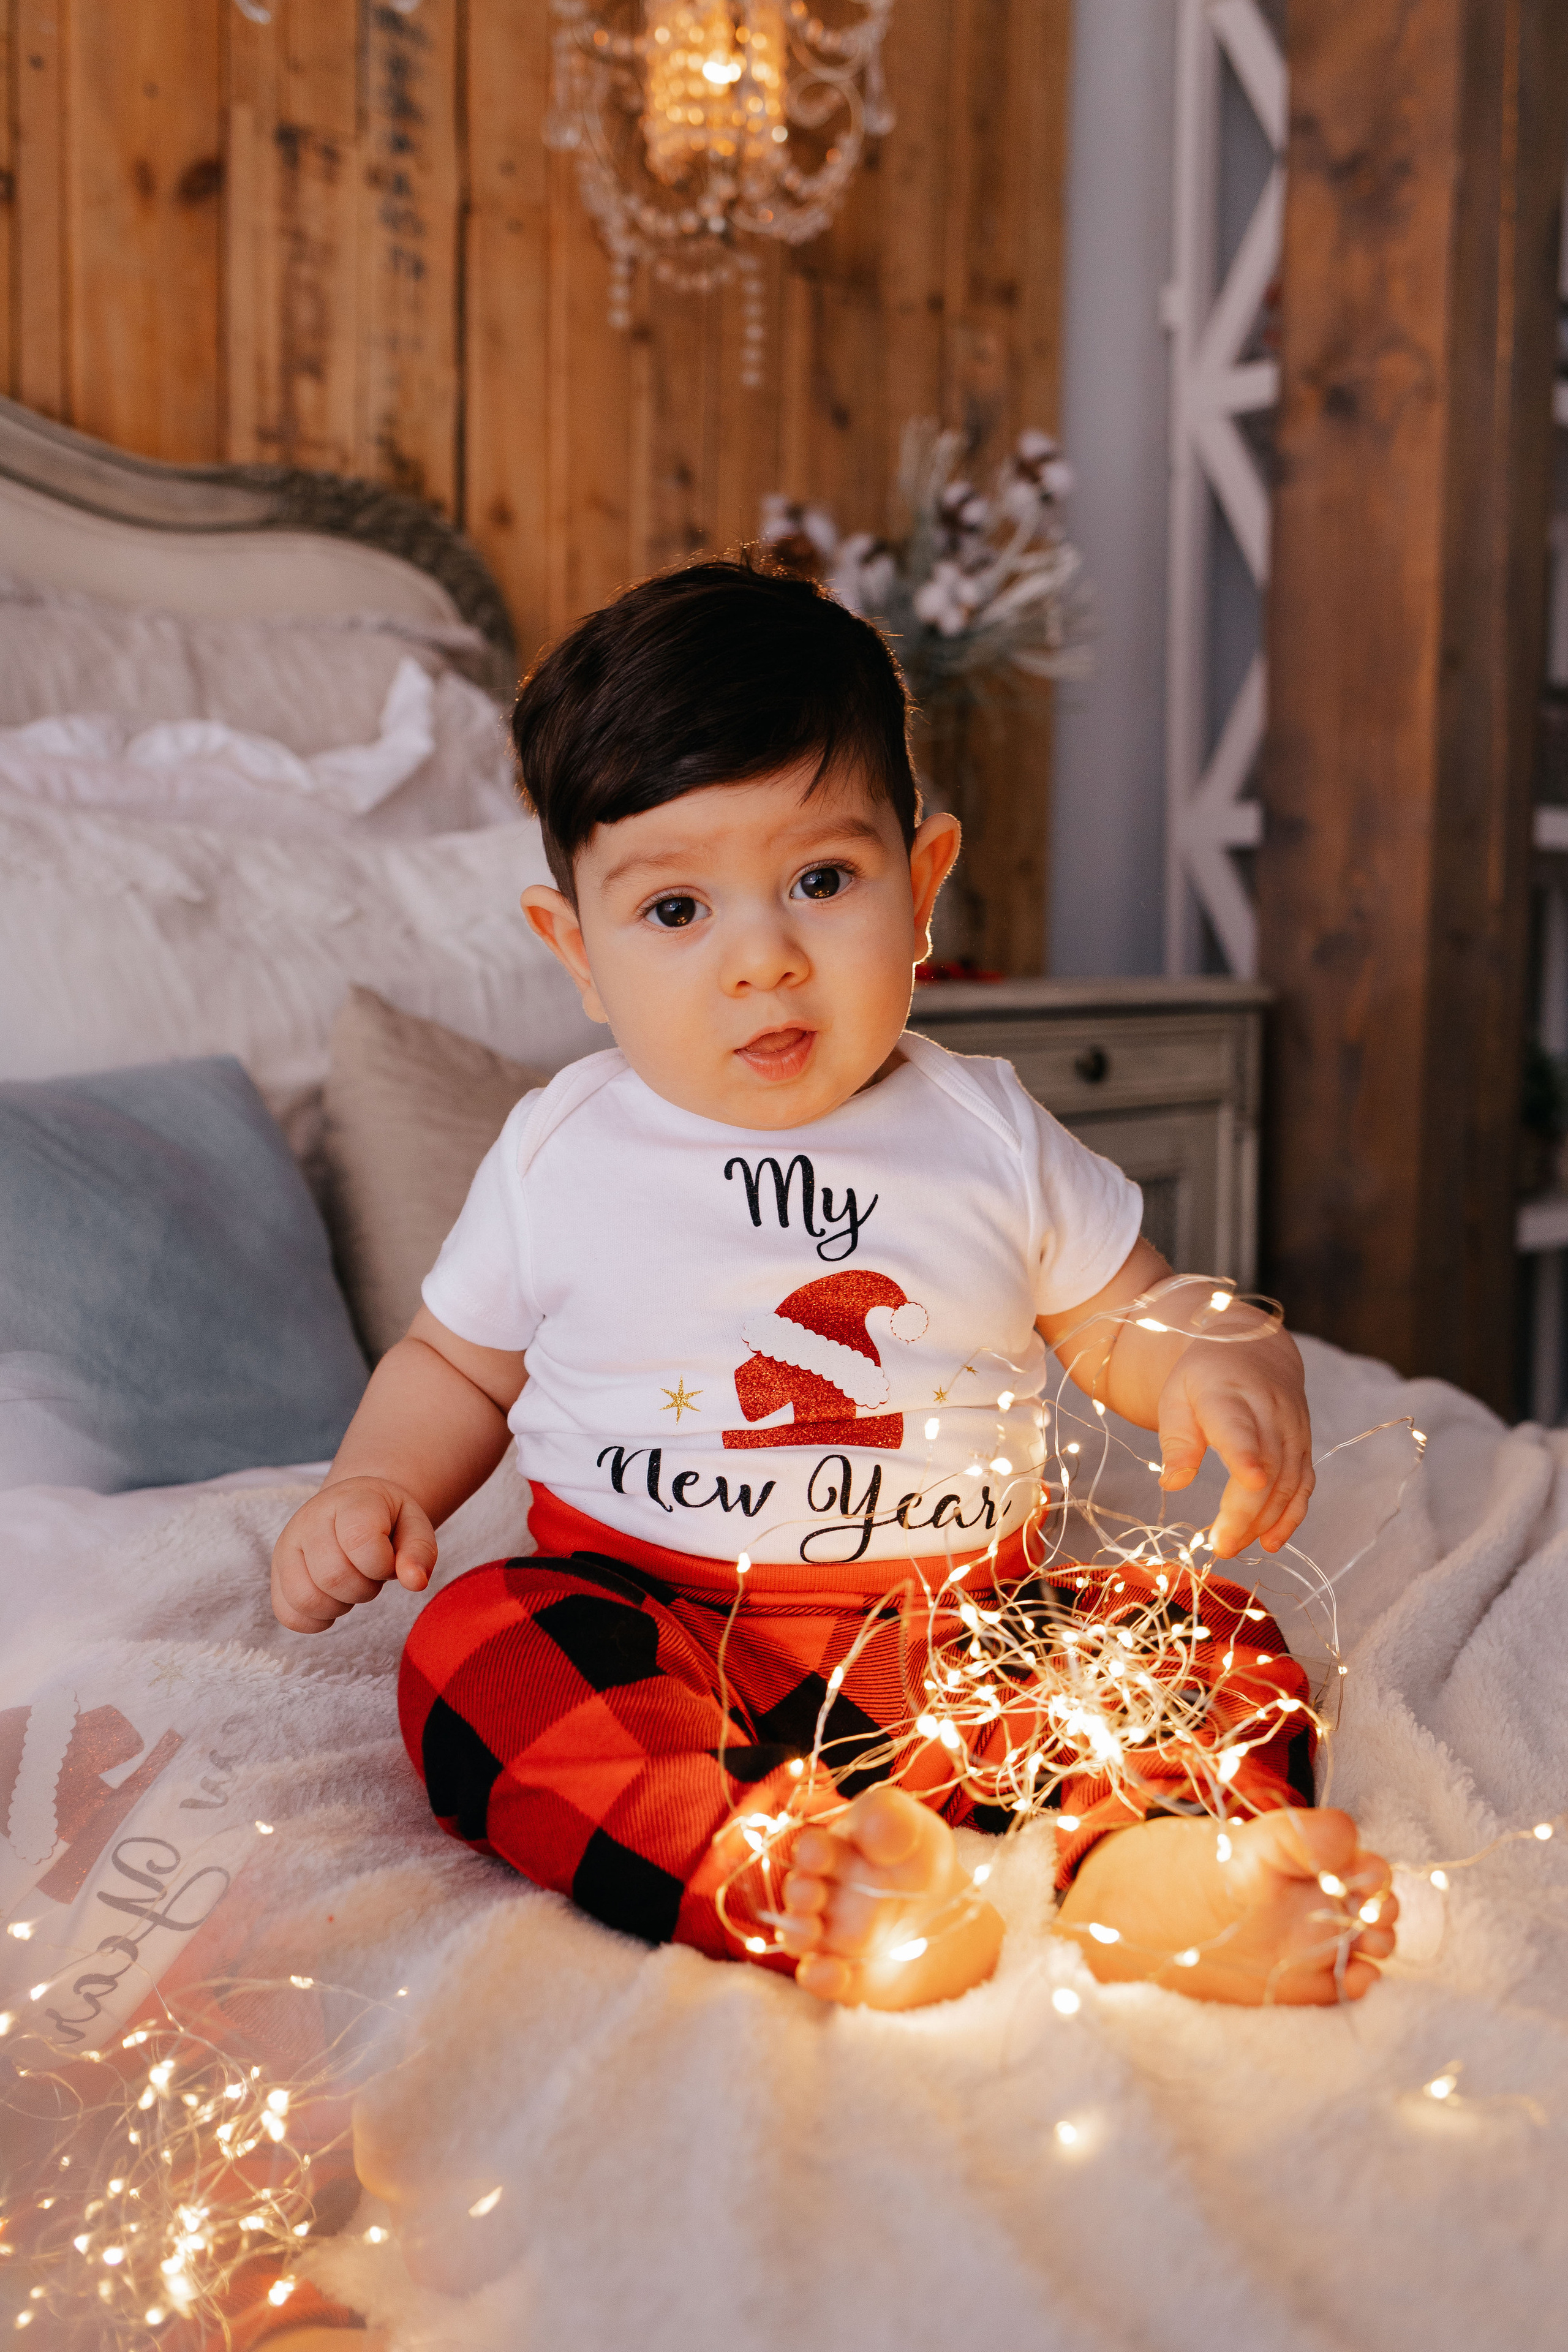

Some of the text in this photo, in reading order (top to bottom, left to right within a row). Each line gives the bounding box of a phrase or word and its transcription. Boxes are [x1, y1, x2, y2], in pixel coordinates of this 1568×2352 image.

[723, 1155, 879, 1262] My
[597, 1445, 1012, 1564] New Year
